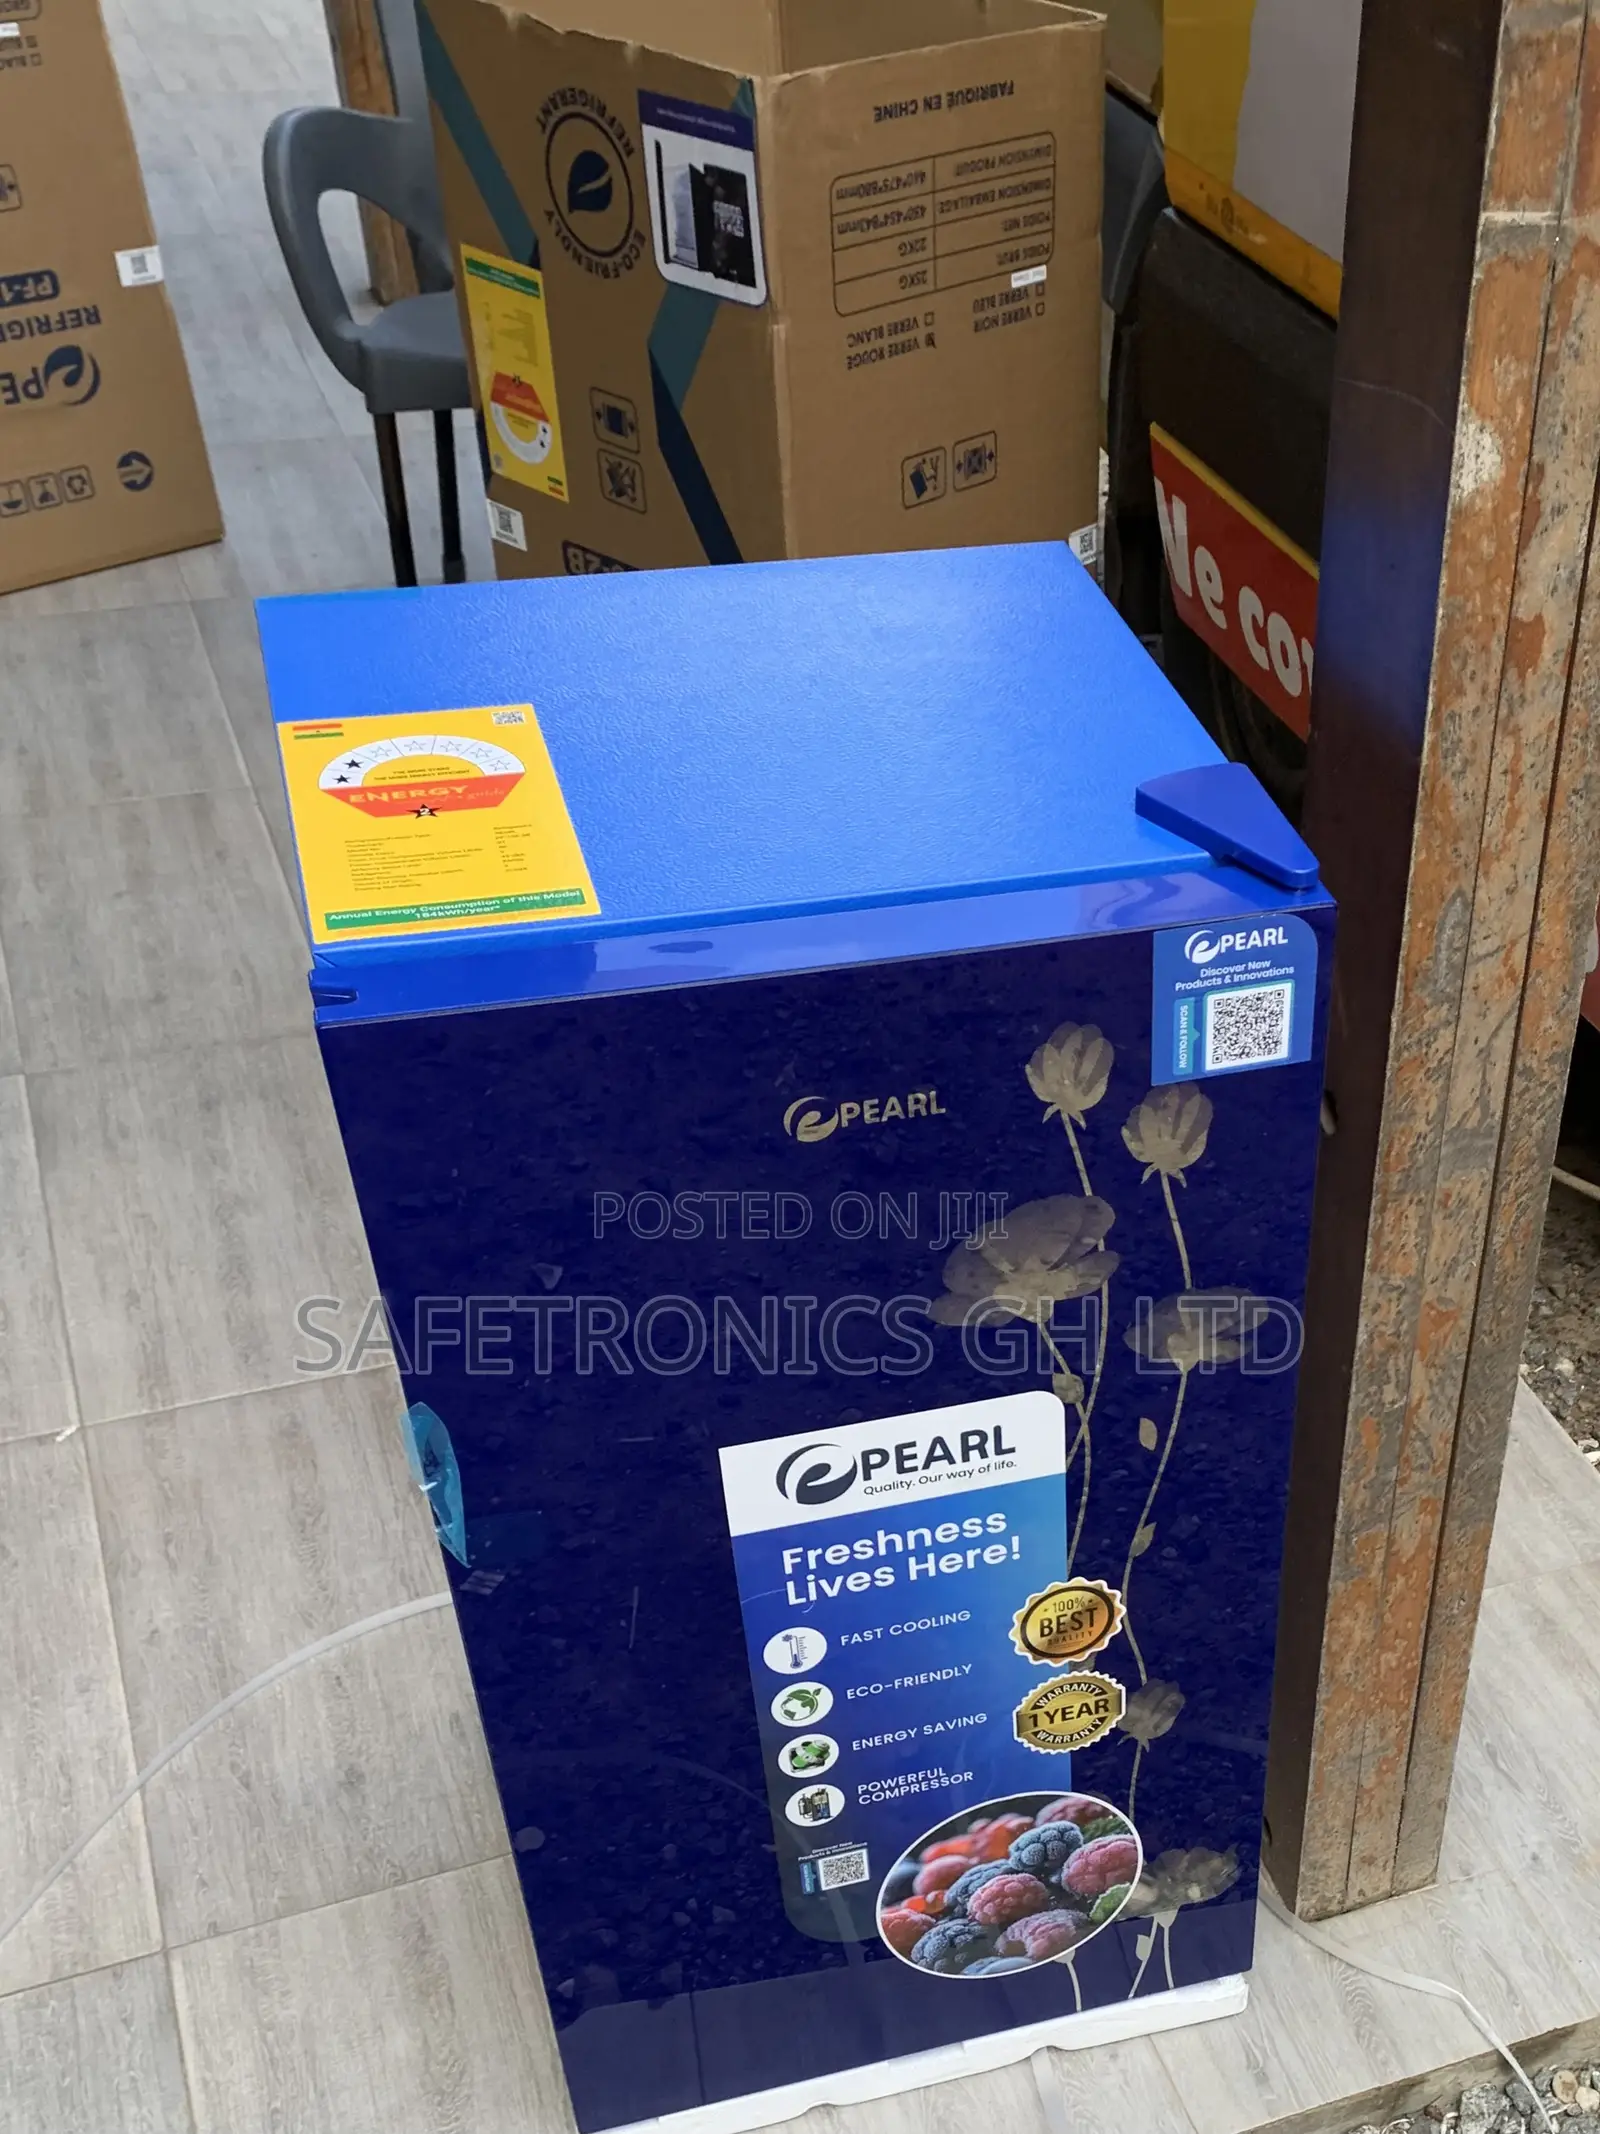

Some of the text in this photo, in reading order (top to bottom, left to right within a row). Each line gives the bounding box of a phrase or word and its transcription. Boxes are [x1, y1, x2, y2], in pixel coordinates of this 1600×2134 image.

[873, 101, 918, 123] CHINE
[922, 94, 942, 111] EN
[536, 88, 634, 158] REFRIGERANT
[544, 209, 646, 279] ECO-FRIENDLY
[898, 237, 927, 257] 22KG
[0, 304, 101, 342] REFRIG
[847, 316, 919, 348] VERRE BLANC
[847, 336, 920, 370] VERRE ROUGE
[348, 785, 469, 803] ENERGY
[329, 890, 581, 920] Annual Energy Consumption of this Model
[1219, 926, 1288, 953] PEARL
[1175, 966, 1295, 991] Products & Innovations
[1200, 961, 1247, 978] Discover
[1180, 1004, 1189, 1029] SCAN
[1179, 1034, 1188, 1068] FOLLOW
[840, 1090, 946, 1128] PEARL
[860, 1425, 1016, 1481] PEARL
[863, 1457, 1018, 1497] Quality. Our way of life.
[781, 1511, 1008, 1575] Freshness
[785, 1535, 1021, 1607] Lives Here!
[1052, 1596, 1086, 1613] 100%
[840, 1610, 972, 1647] FAST COOLING
[1040, 1607, 1098, 1638] BEST
[1047, 1631, 1094, 1646] QUALITY
[846, 1664, 973, 1699] ECO-FRIENDLY
[1036, 1683, 1103, 1707] WARRANTY
[1029, 1699, 1110, 1728] 1 YEAR
[852, 1712, 988, 1751] ENERGY SAVING
[1036, 1718, 1103, 1744] WARRANTY
[857, 1766, 946, 1795] POWERFUL
[858, 1771, 974, 1806] COMPRESSOR
